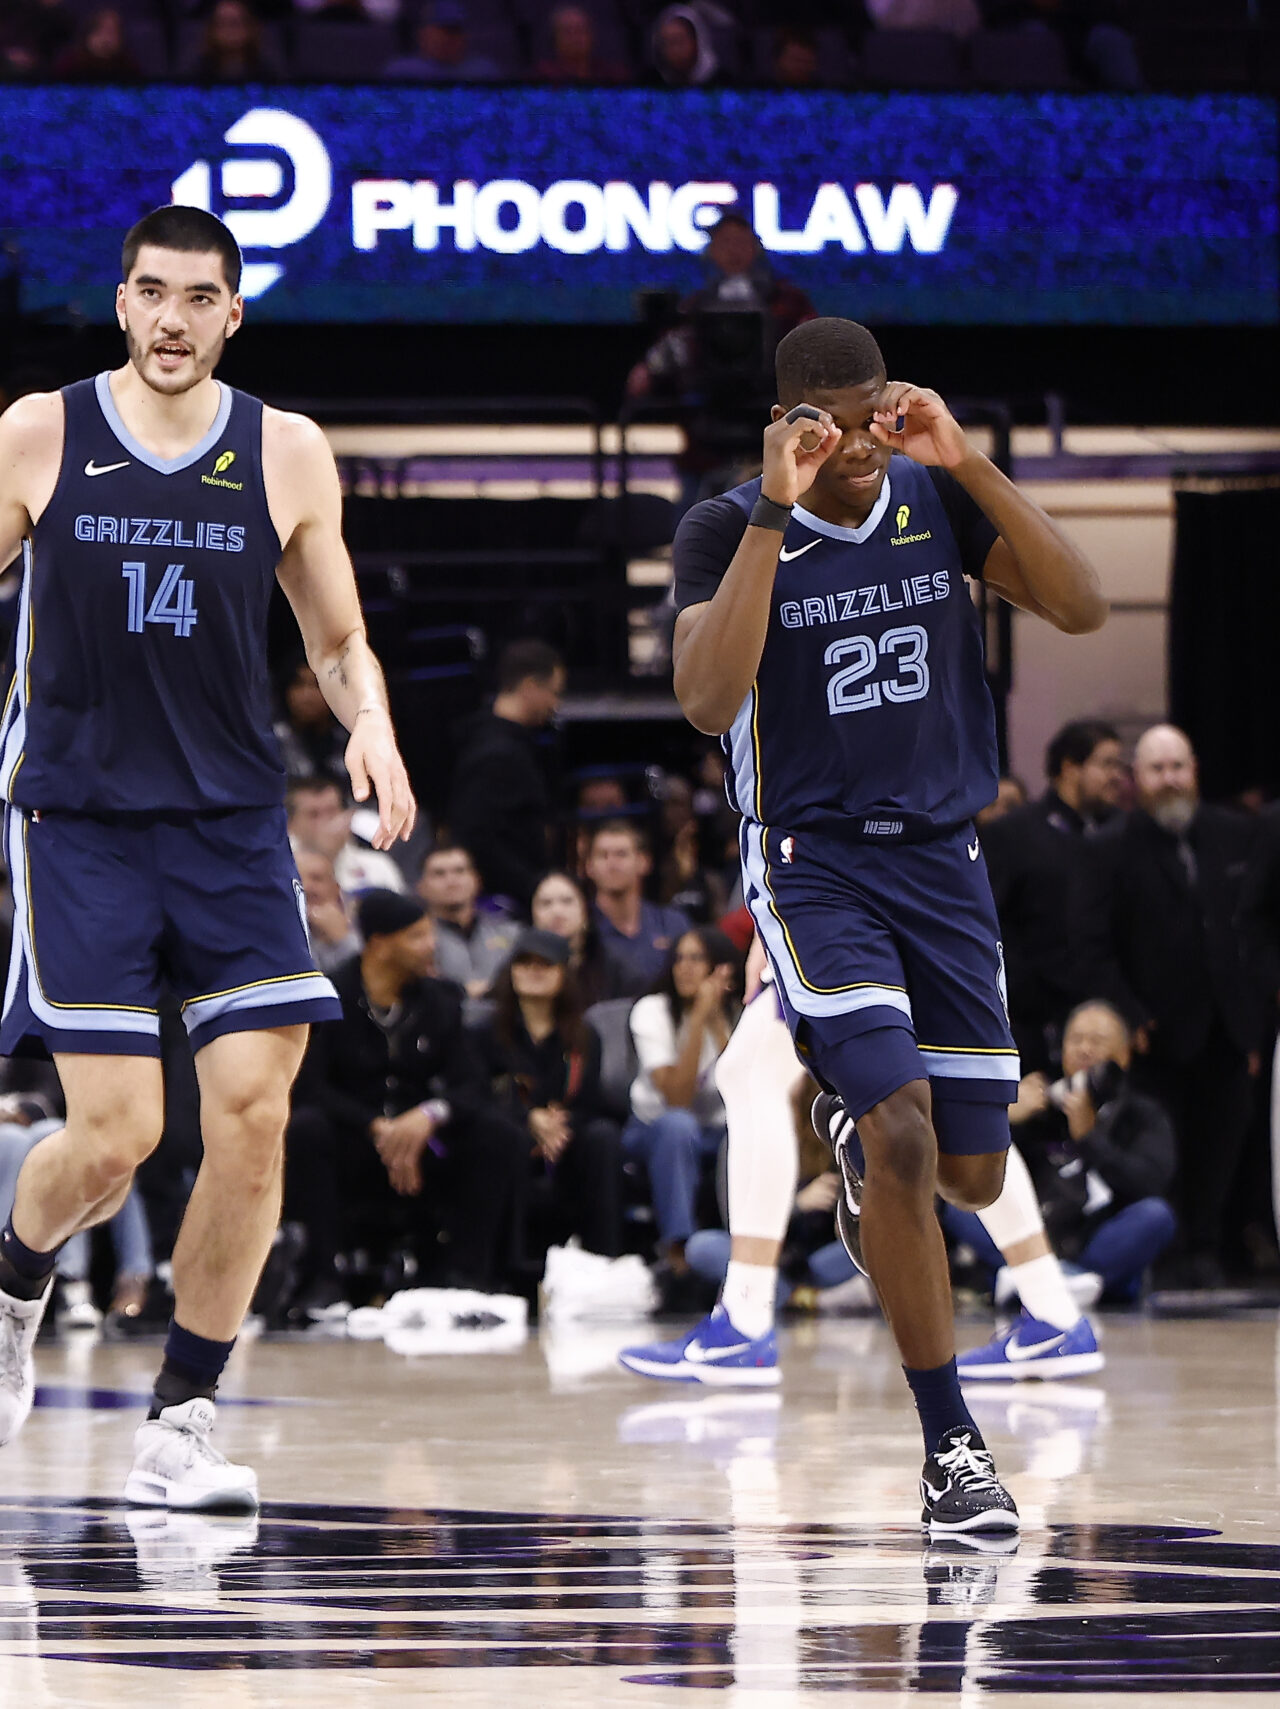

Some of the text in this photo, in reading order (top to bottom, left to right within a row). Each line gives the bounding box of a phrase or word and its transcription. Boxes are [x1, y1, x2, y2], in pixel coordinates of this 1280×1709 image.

[753, 182, 959, 255] LAW
[201, 475, 243, 491] Robinhood
[74, 514, 245, 552] GRIZZLIES
[890, 530, 931, 546] Robinhood
[122, 561, 198, 637] 14
[779, 570, 950, 629] GRIZZLIES
[823, 624, 930, 715] 23
